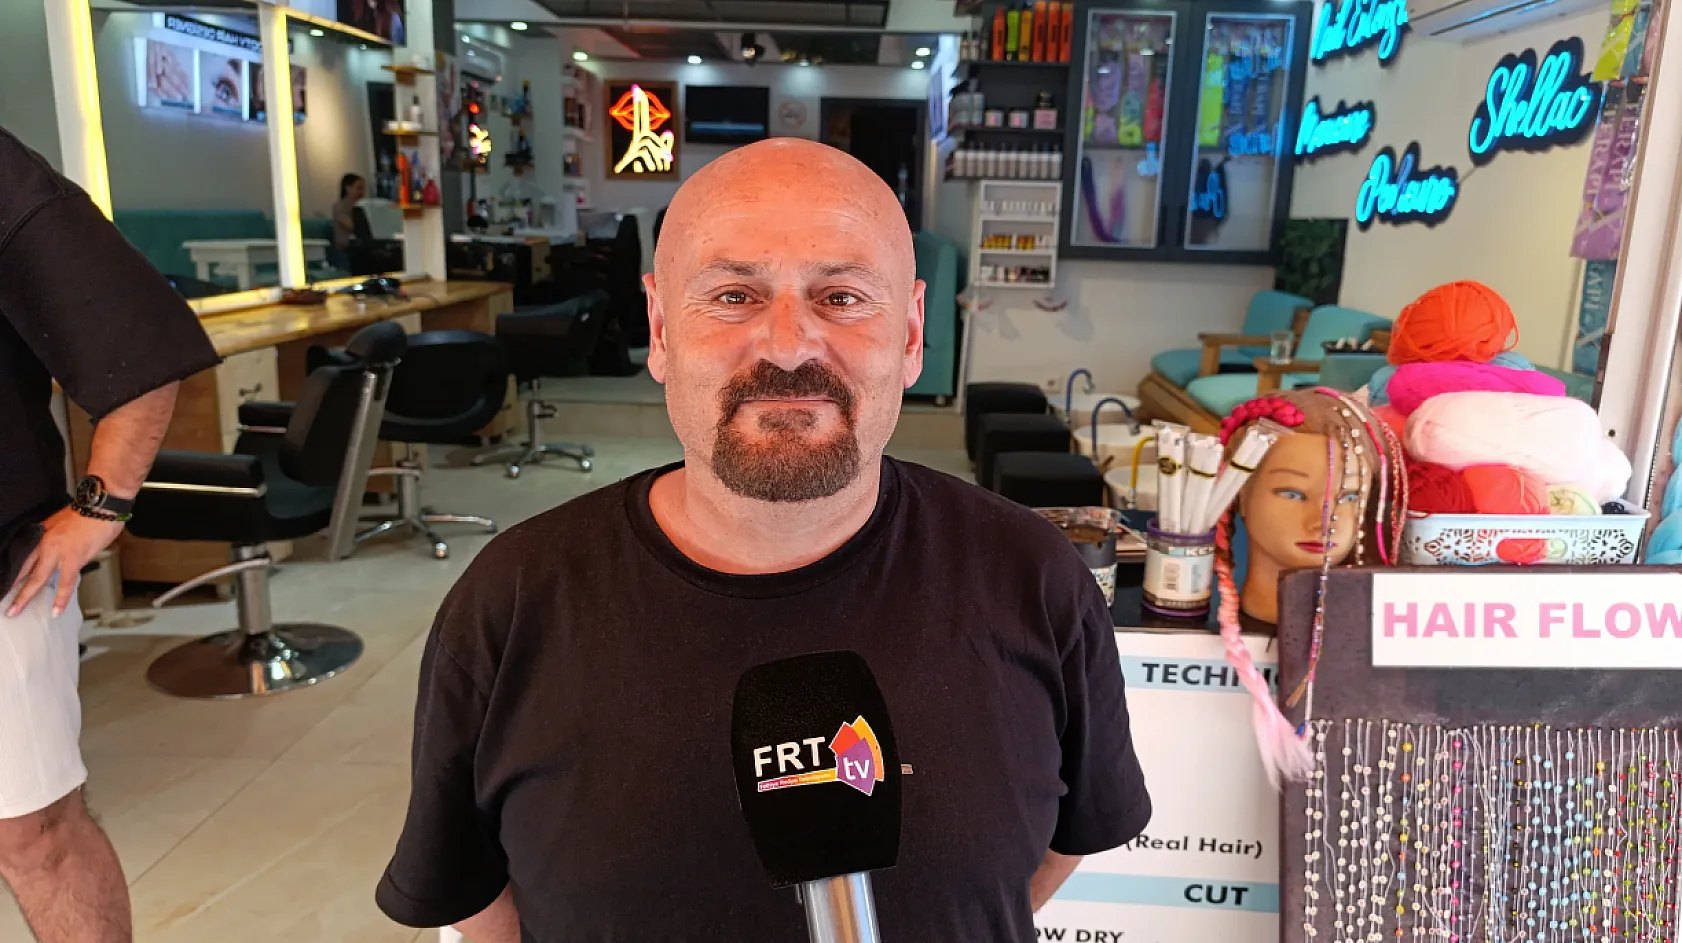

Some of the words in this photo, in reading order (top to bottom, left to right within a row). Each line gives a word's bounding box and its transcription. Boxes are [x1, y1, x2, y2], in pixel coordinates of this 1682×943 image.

[1469, 51, 1590, 155] Shellac
[1383, 602, 1518, 639] HAIR
[753, 736, 826, 778] FRT
[842, 756, 870, 781] tv
[1198, 836, 1263, 859] Hair)
[1184, 884, 1249, 905] CUT
[1076, 928, 1125, 943] DRY
